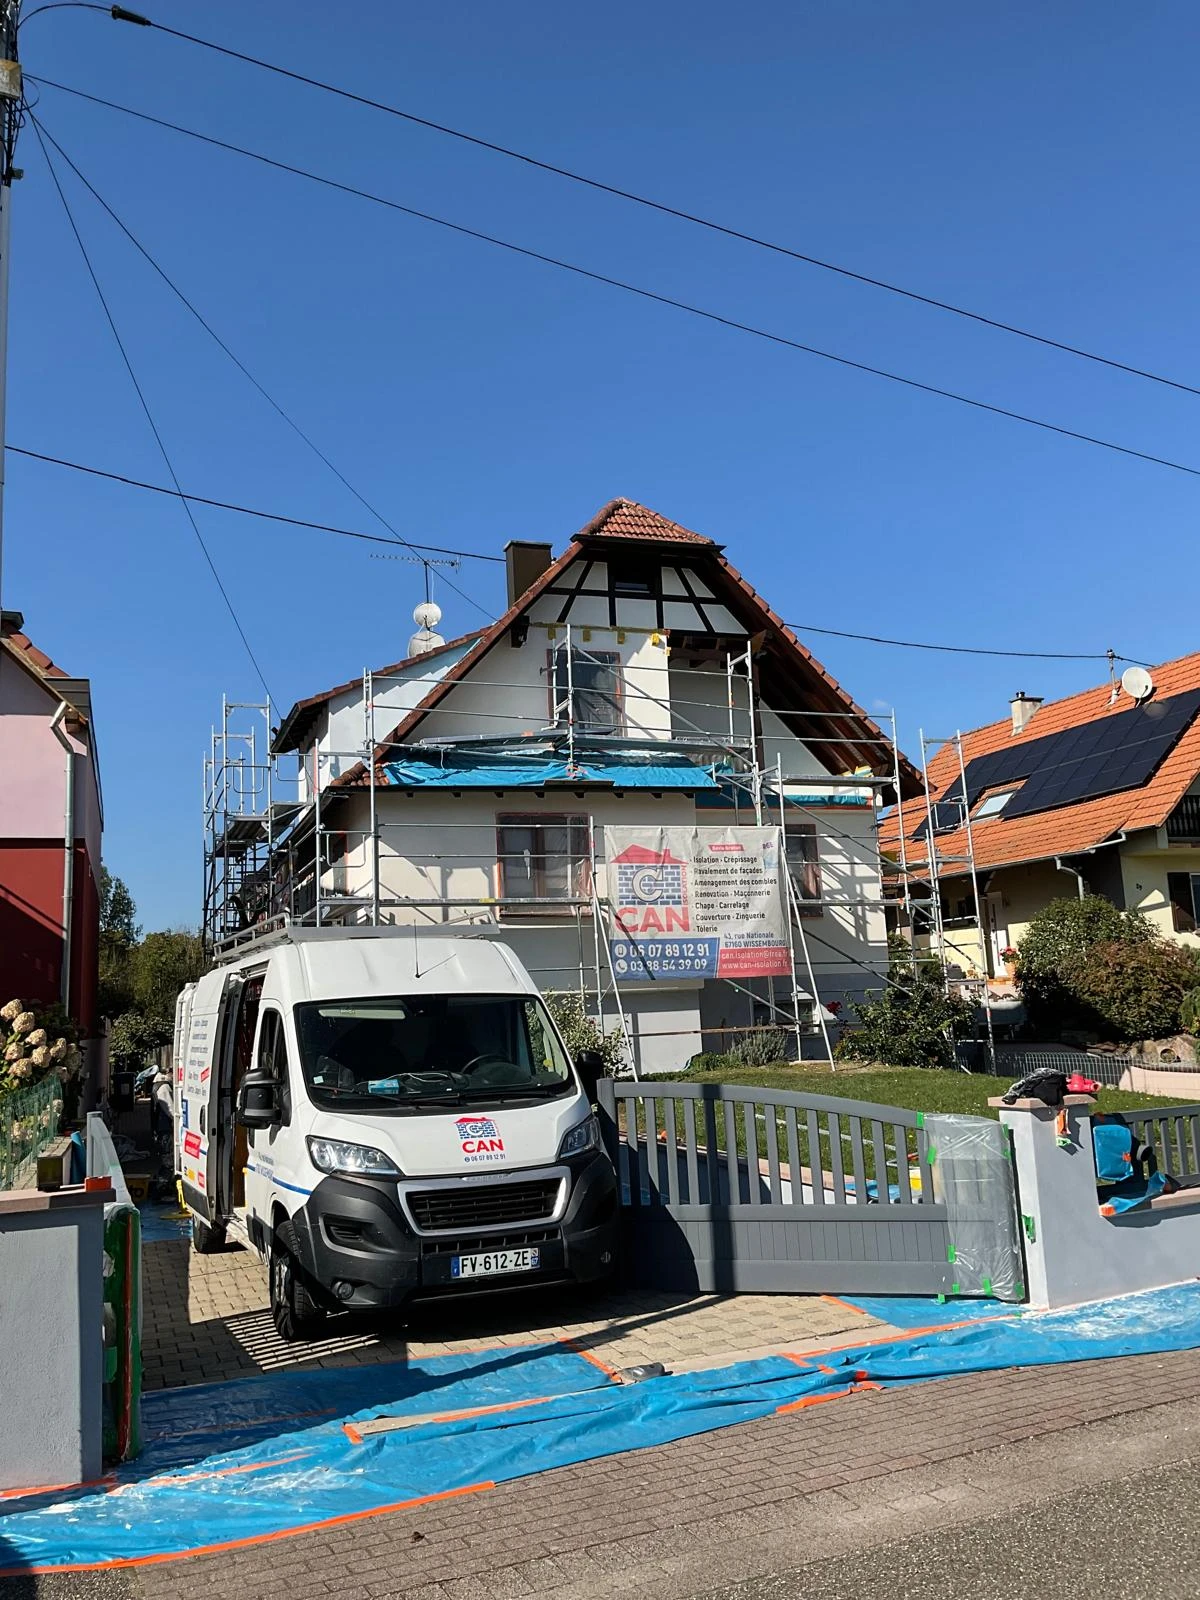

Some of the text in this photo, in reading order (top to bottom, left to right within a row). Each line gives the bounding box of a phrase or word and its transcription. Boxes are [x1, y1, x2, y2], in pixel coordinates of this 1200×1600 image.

[723, 856, 757, 864] Crépissage
[693, 867, 729, 875] Ravalement
[740, 866, 763, 875] façades
[681, 865, 689, 906] ISOLATION
[740, 877, 751, 885] des
[751, 877, 777, 885] combles
[733, 889, 771, 898] Maçonnerie
[719, 901, 750, 909] Carrelage
[615, 906, 690, 933] CAN
[735, 912, 766, 920] Zinguerie
[746, 931, 774, 939] Nationale
[629, 943, 710, 958] 06 07 89 12 91
[630, 960, 643, 972] 03
[662, 959, 676, 971] 54
[678, 958, 691, 970] 39
[694, 959, 707, 970] 09
[462, 1139, 504, 1153] CAN
[461, 1250, 529, 1274] FV-612-ZE
